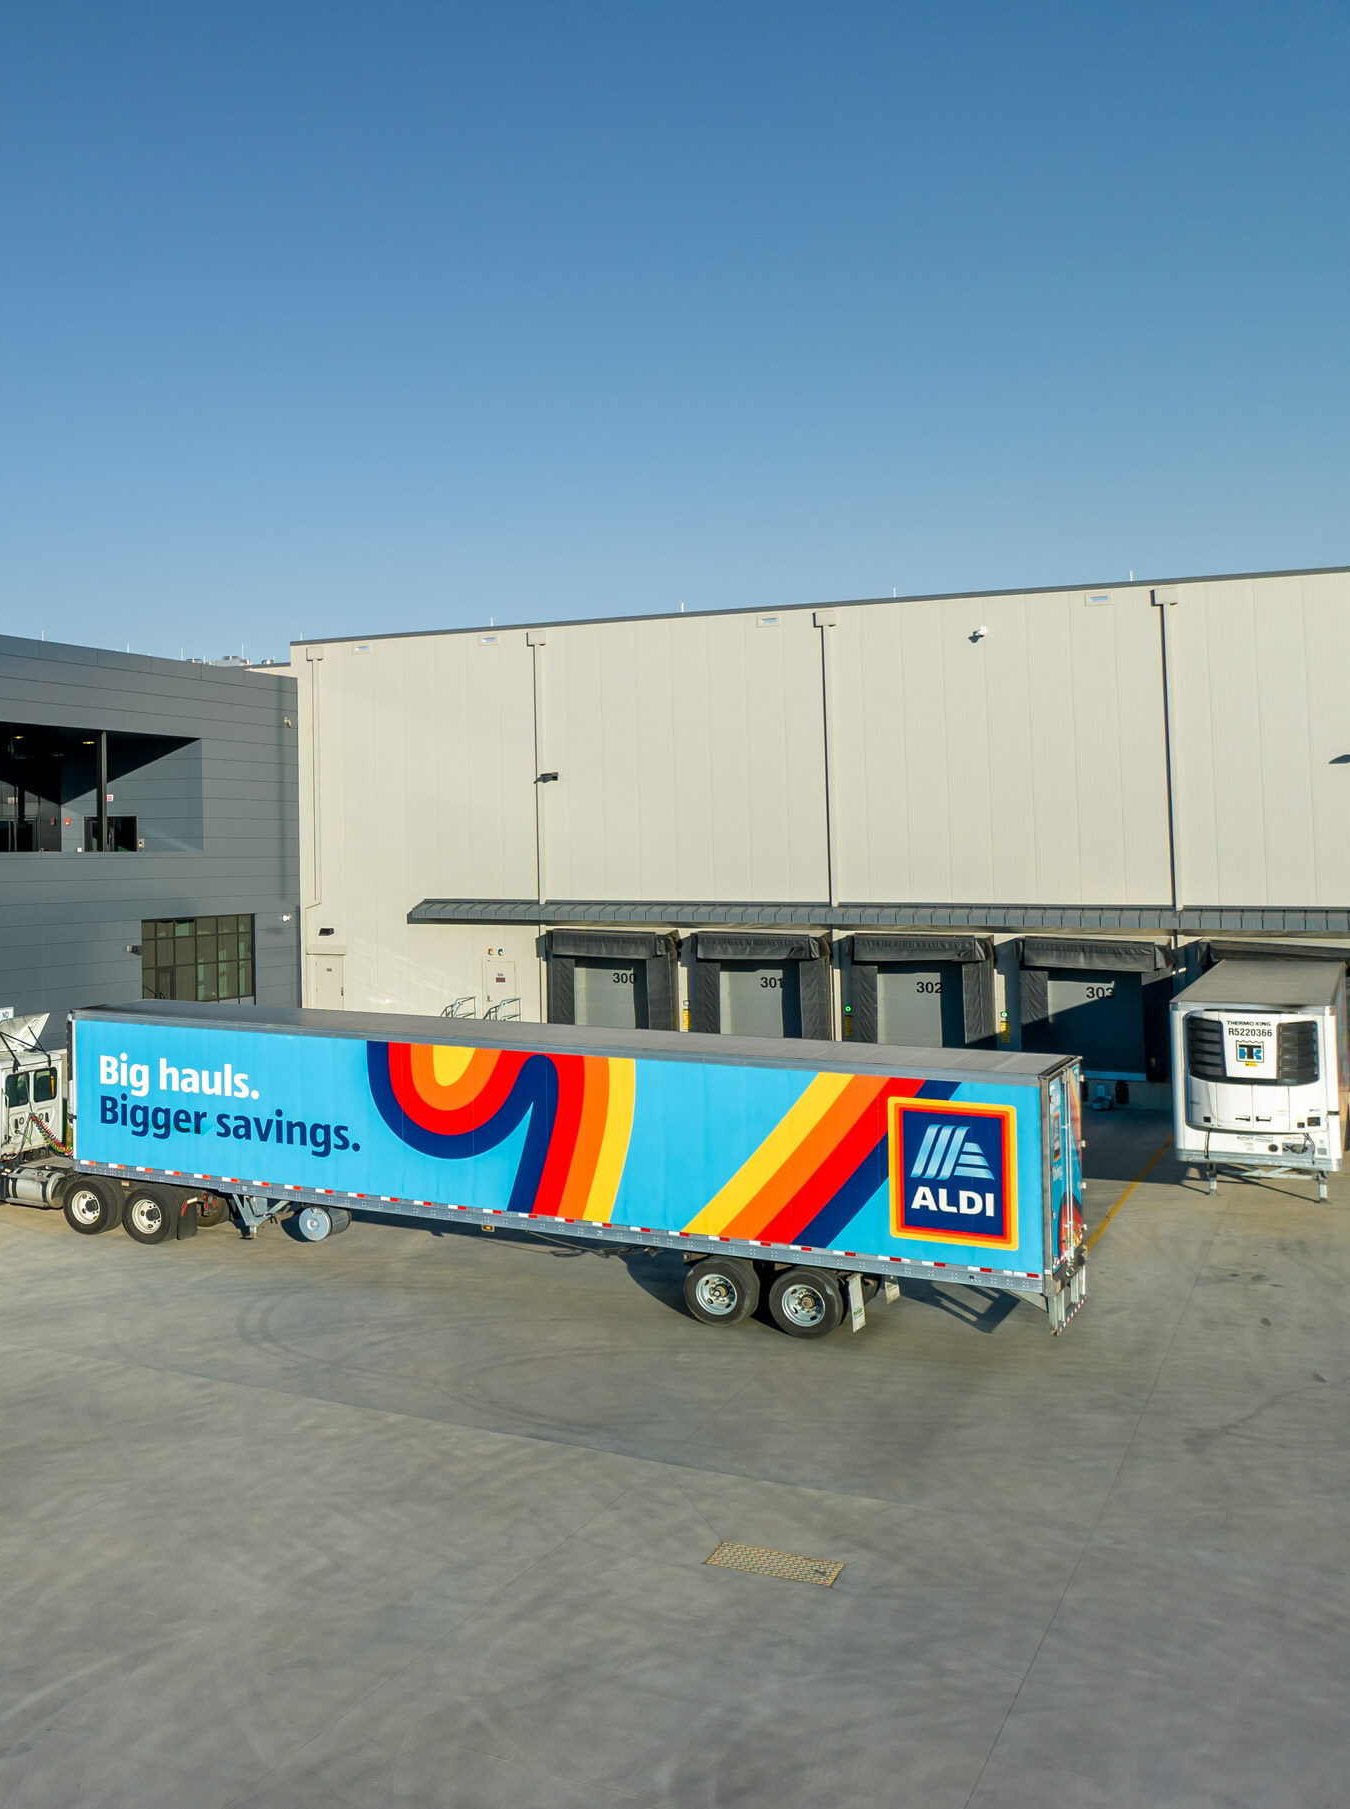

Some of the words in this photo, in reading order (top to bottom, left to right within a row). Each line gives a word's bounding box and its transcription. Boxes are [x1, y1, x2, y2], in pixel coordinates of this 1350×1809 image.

[612, 972, 637, 984] 300
[760, 976, 783, 989] 301
[916, 981, 943, 994] 302
[1086, 986, 1114, 999] 303
[1228, 1028, 1272, 1037] R5220366
[100, 1052, 150, 1097] Big
[159, 1057, 260, 1100] hauls.
[100, 1093, 208, 1140] Bigger
[216, 1108, 361, 1158] savings.
[910, 1186, 995, 1217] ALDI
